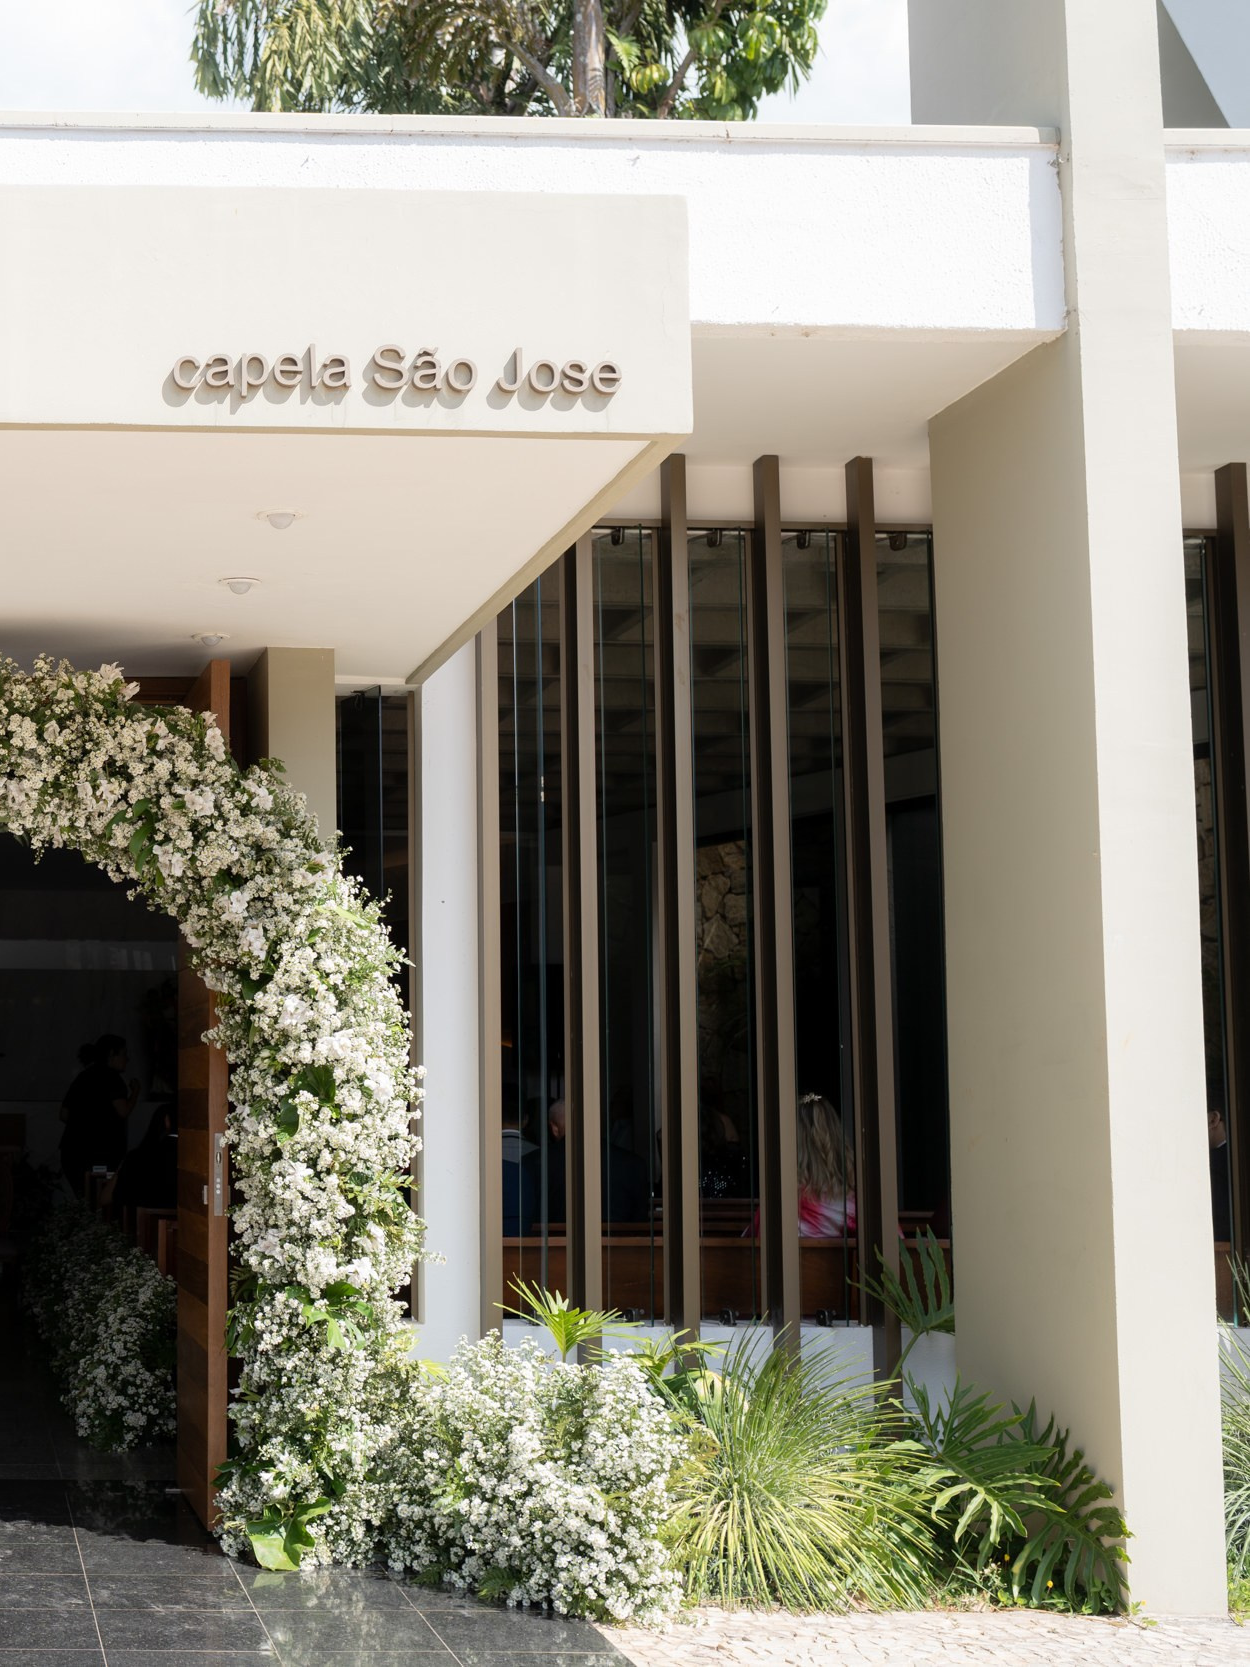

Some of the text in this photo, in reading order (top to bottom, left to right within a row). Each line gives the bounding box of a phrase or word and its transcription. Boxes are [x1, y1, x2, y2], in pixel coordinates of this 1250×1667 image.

[172, 343, 623, 398] capela São Jose
